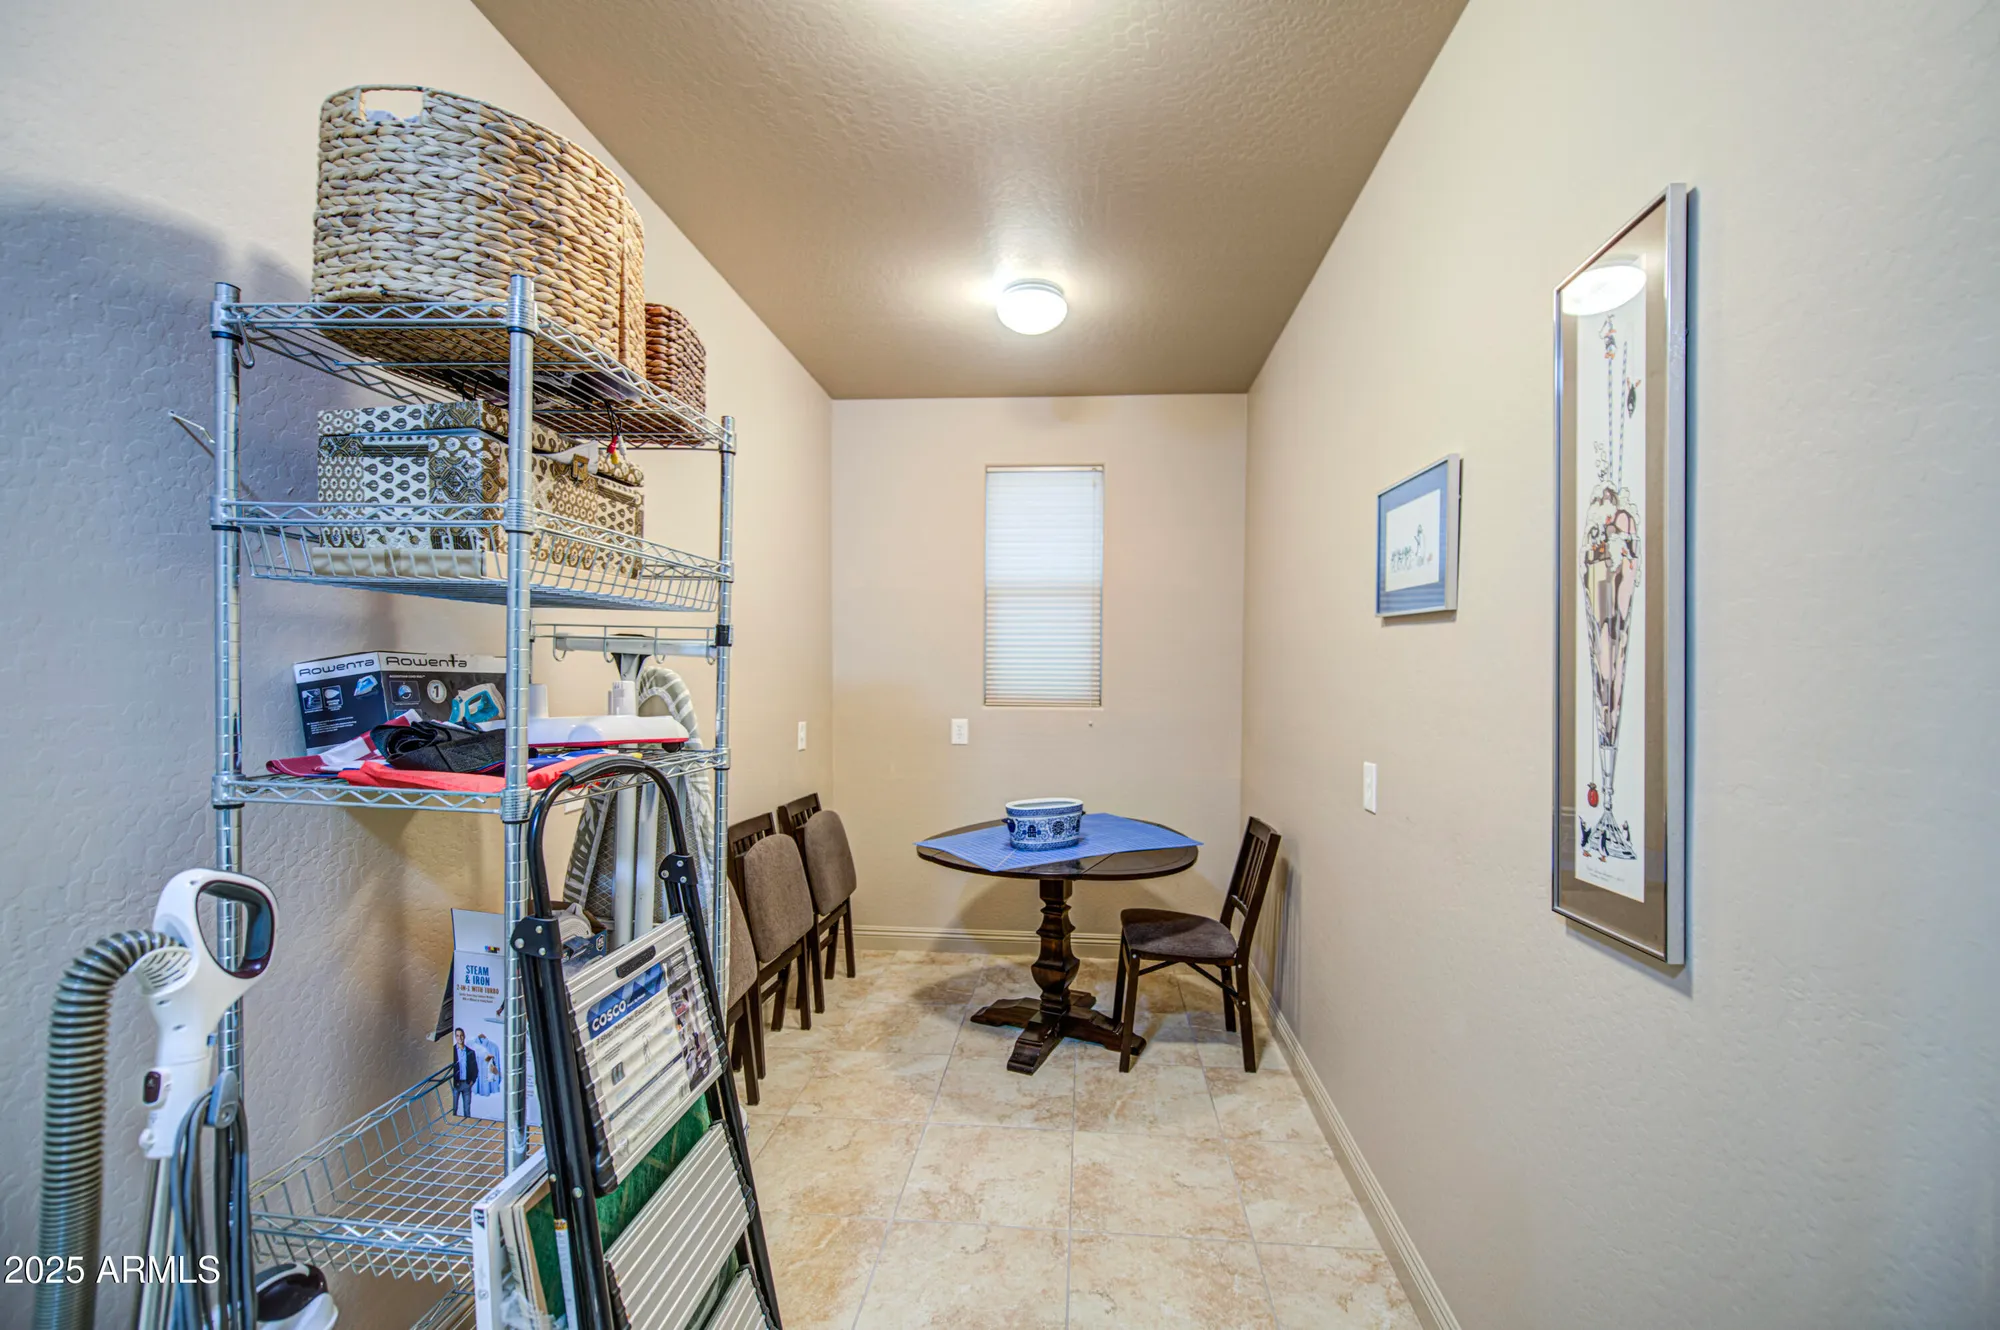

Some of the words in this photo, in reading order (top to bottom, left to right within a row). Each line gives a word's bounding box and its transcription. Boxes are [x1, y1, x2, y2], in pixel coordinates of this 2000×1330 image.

[386, 654, 468, 668] Rowenta
[465, 965, 489, 976] STEAM
[465, 975, 470, 984] &
[473, 976, 490, 986] IRON
[484, 987, 500, 995] TURBO
[592, 1001, 627, 1030] COSCO
